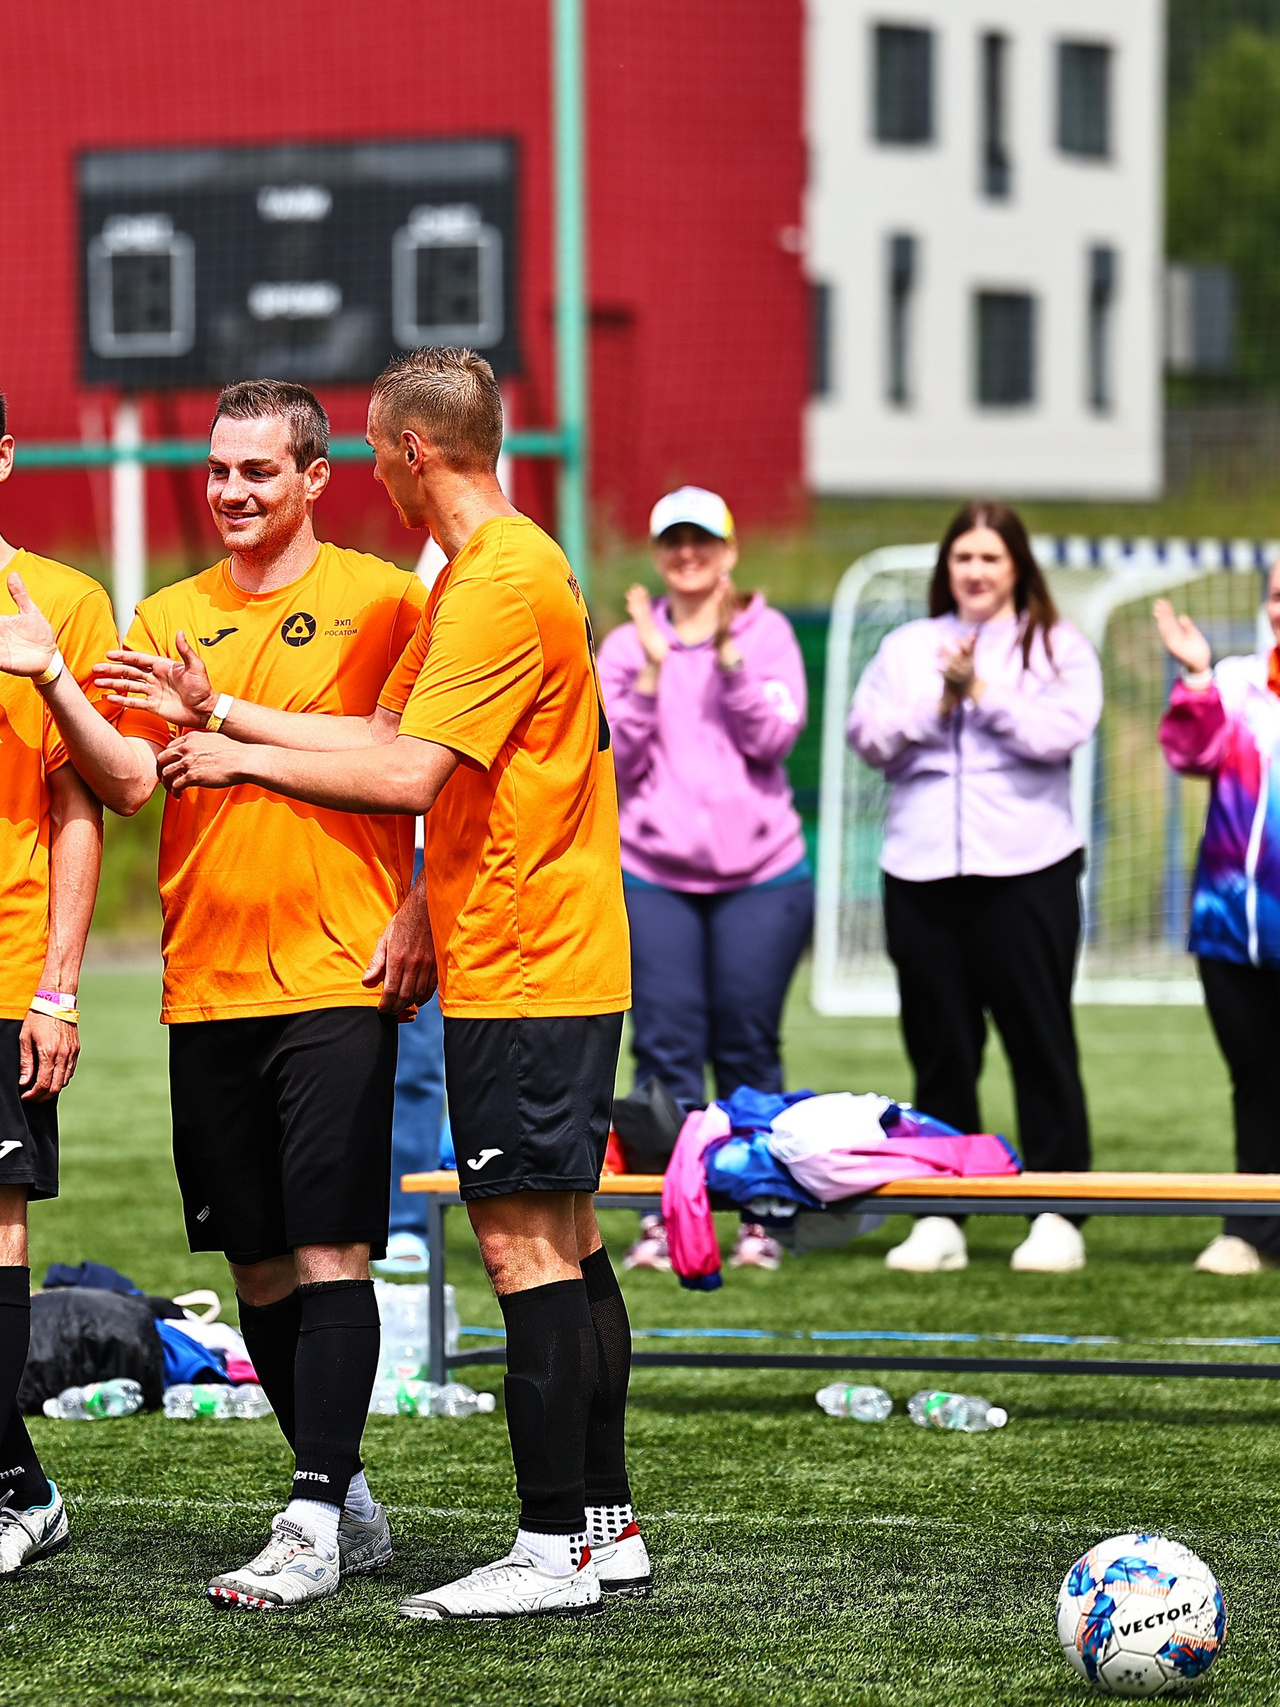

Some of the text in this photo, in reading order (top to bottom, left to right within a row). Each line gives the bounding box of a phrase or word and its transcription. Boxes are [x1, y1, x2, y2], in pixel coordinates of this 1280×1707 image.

[334, 618, 352, 627] ЭХП
[324, 628, 358, 637] РОСАТОМ
[278, 1517, 304, 1533] Joma
[1119, 1603, 1192, 1637] VECTOR
